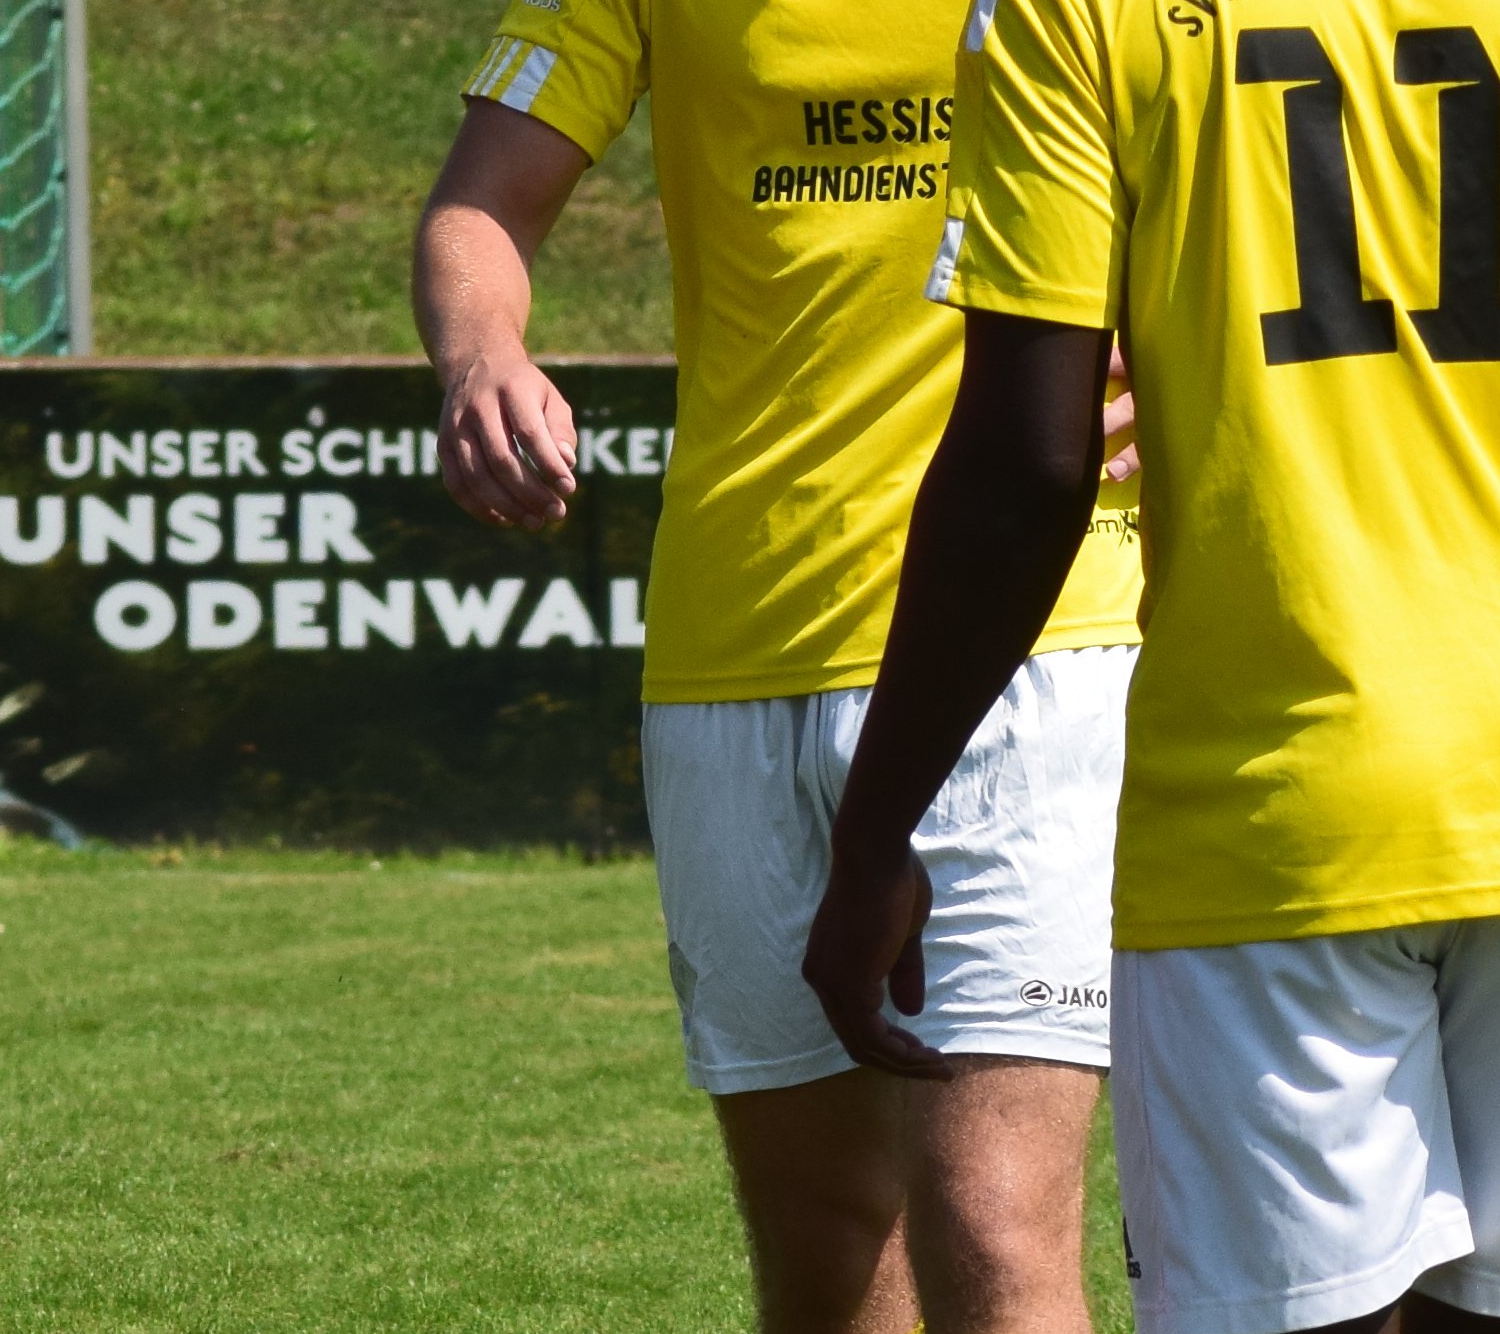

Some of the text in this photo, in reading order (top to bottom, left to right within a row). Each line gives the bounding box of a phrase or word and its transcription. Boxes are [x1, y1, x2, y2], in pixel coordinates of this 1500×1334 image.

[803, 97, 953, 145] HESSIS
[46, 429, 269, 479] UNSER
[93, 578, 645, 651] ODENWAL
[1057, 985, 1107, 1008] JAKO
